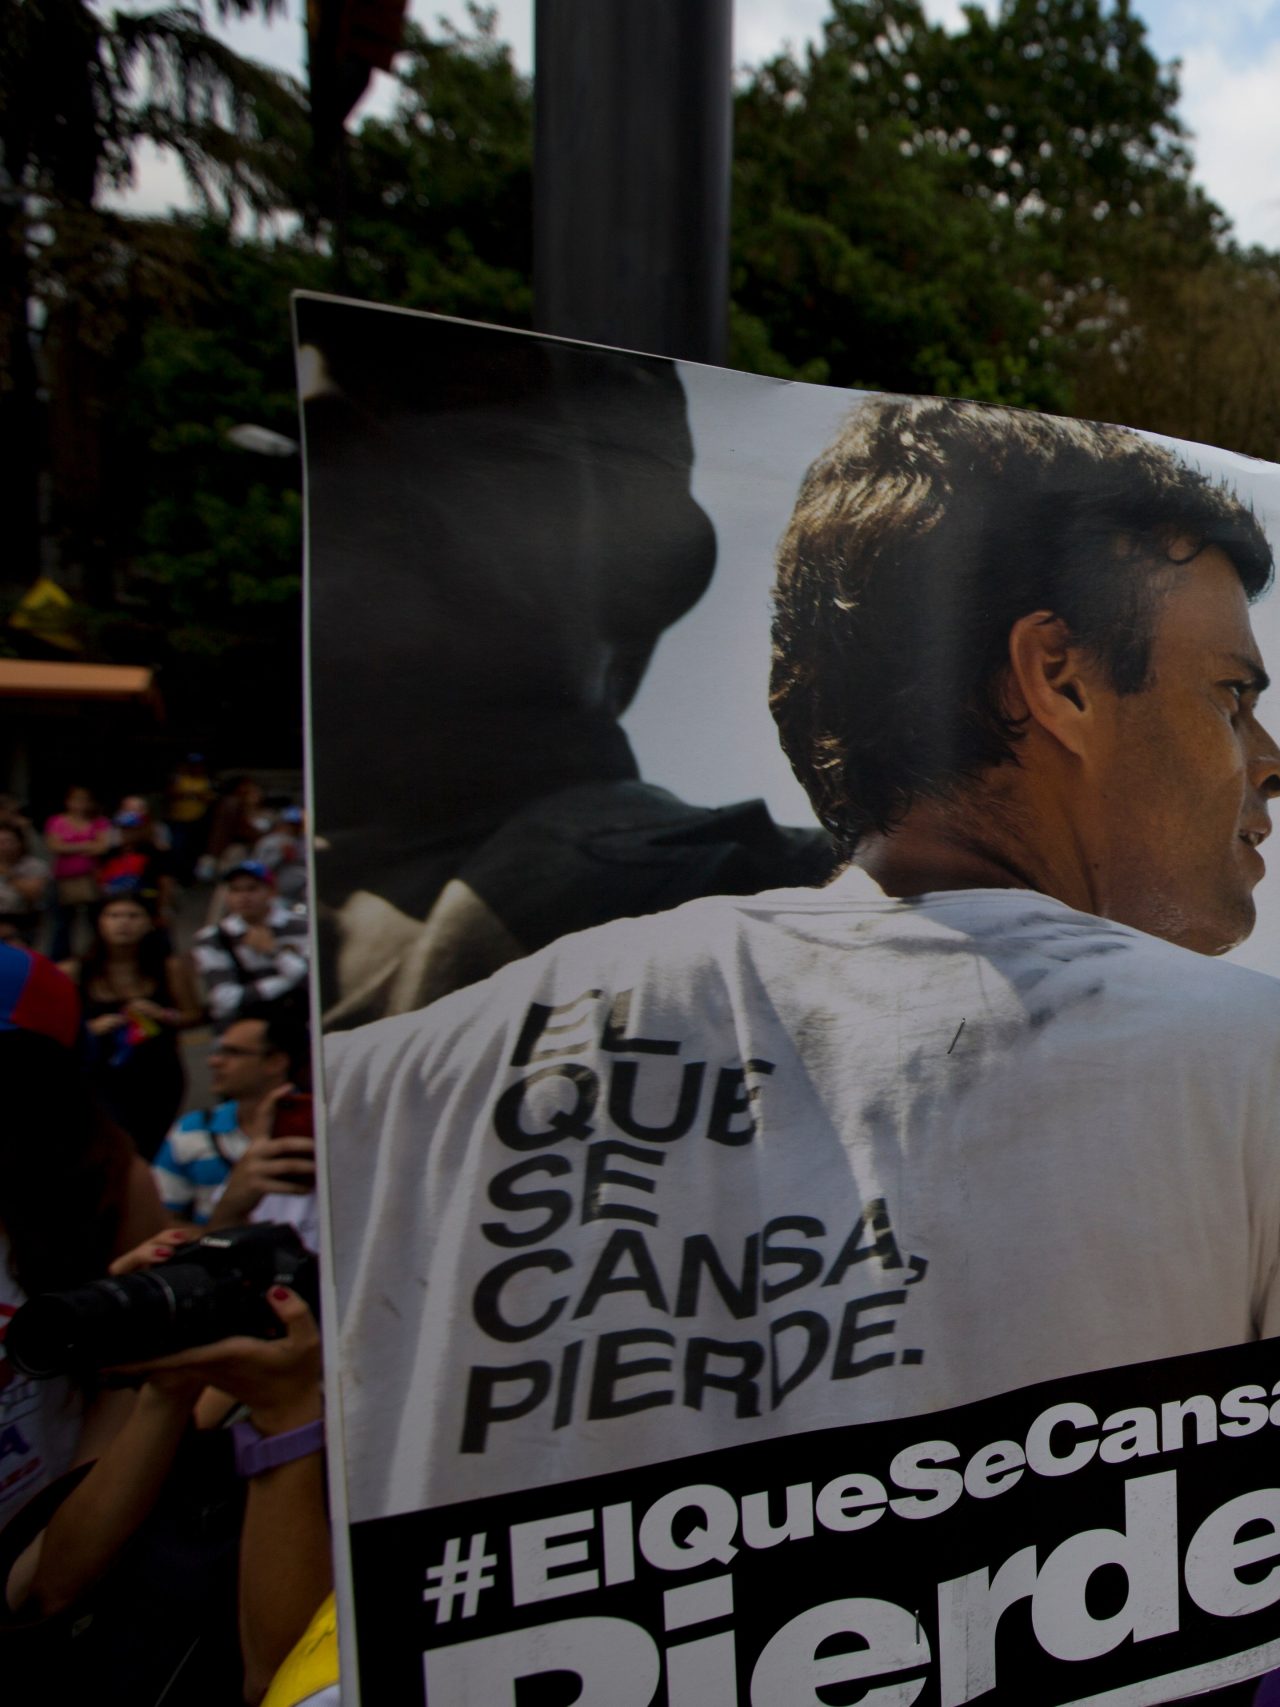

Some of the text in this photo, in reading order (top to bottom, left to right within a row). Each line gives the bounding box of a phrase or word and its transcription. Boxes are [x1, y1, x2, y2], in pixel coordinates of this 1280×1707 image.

[511, 988, 682, 1067] EL
[493, 1058, 776, 1151] QUE
[480, 1139, 667, 1248] SE
[472, 1198, 928, 1343] CANSA,
[459, 1289, 925, 1454] PIERDE.
